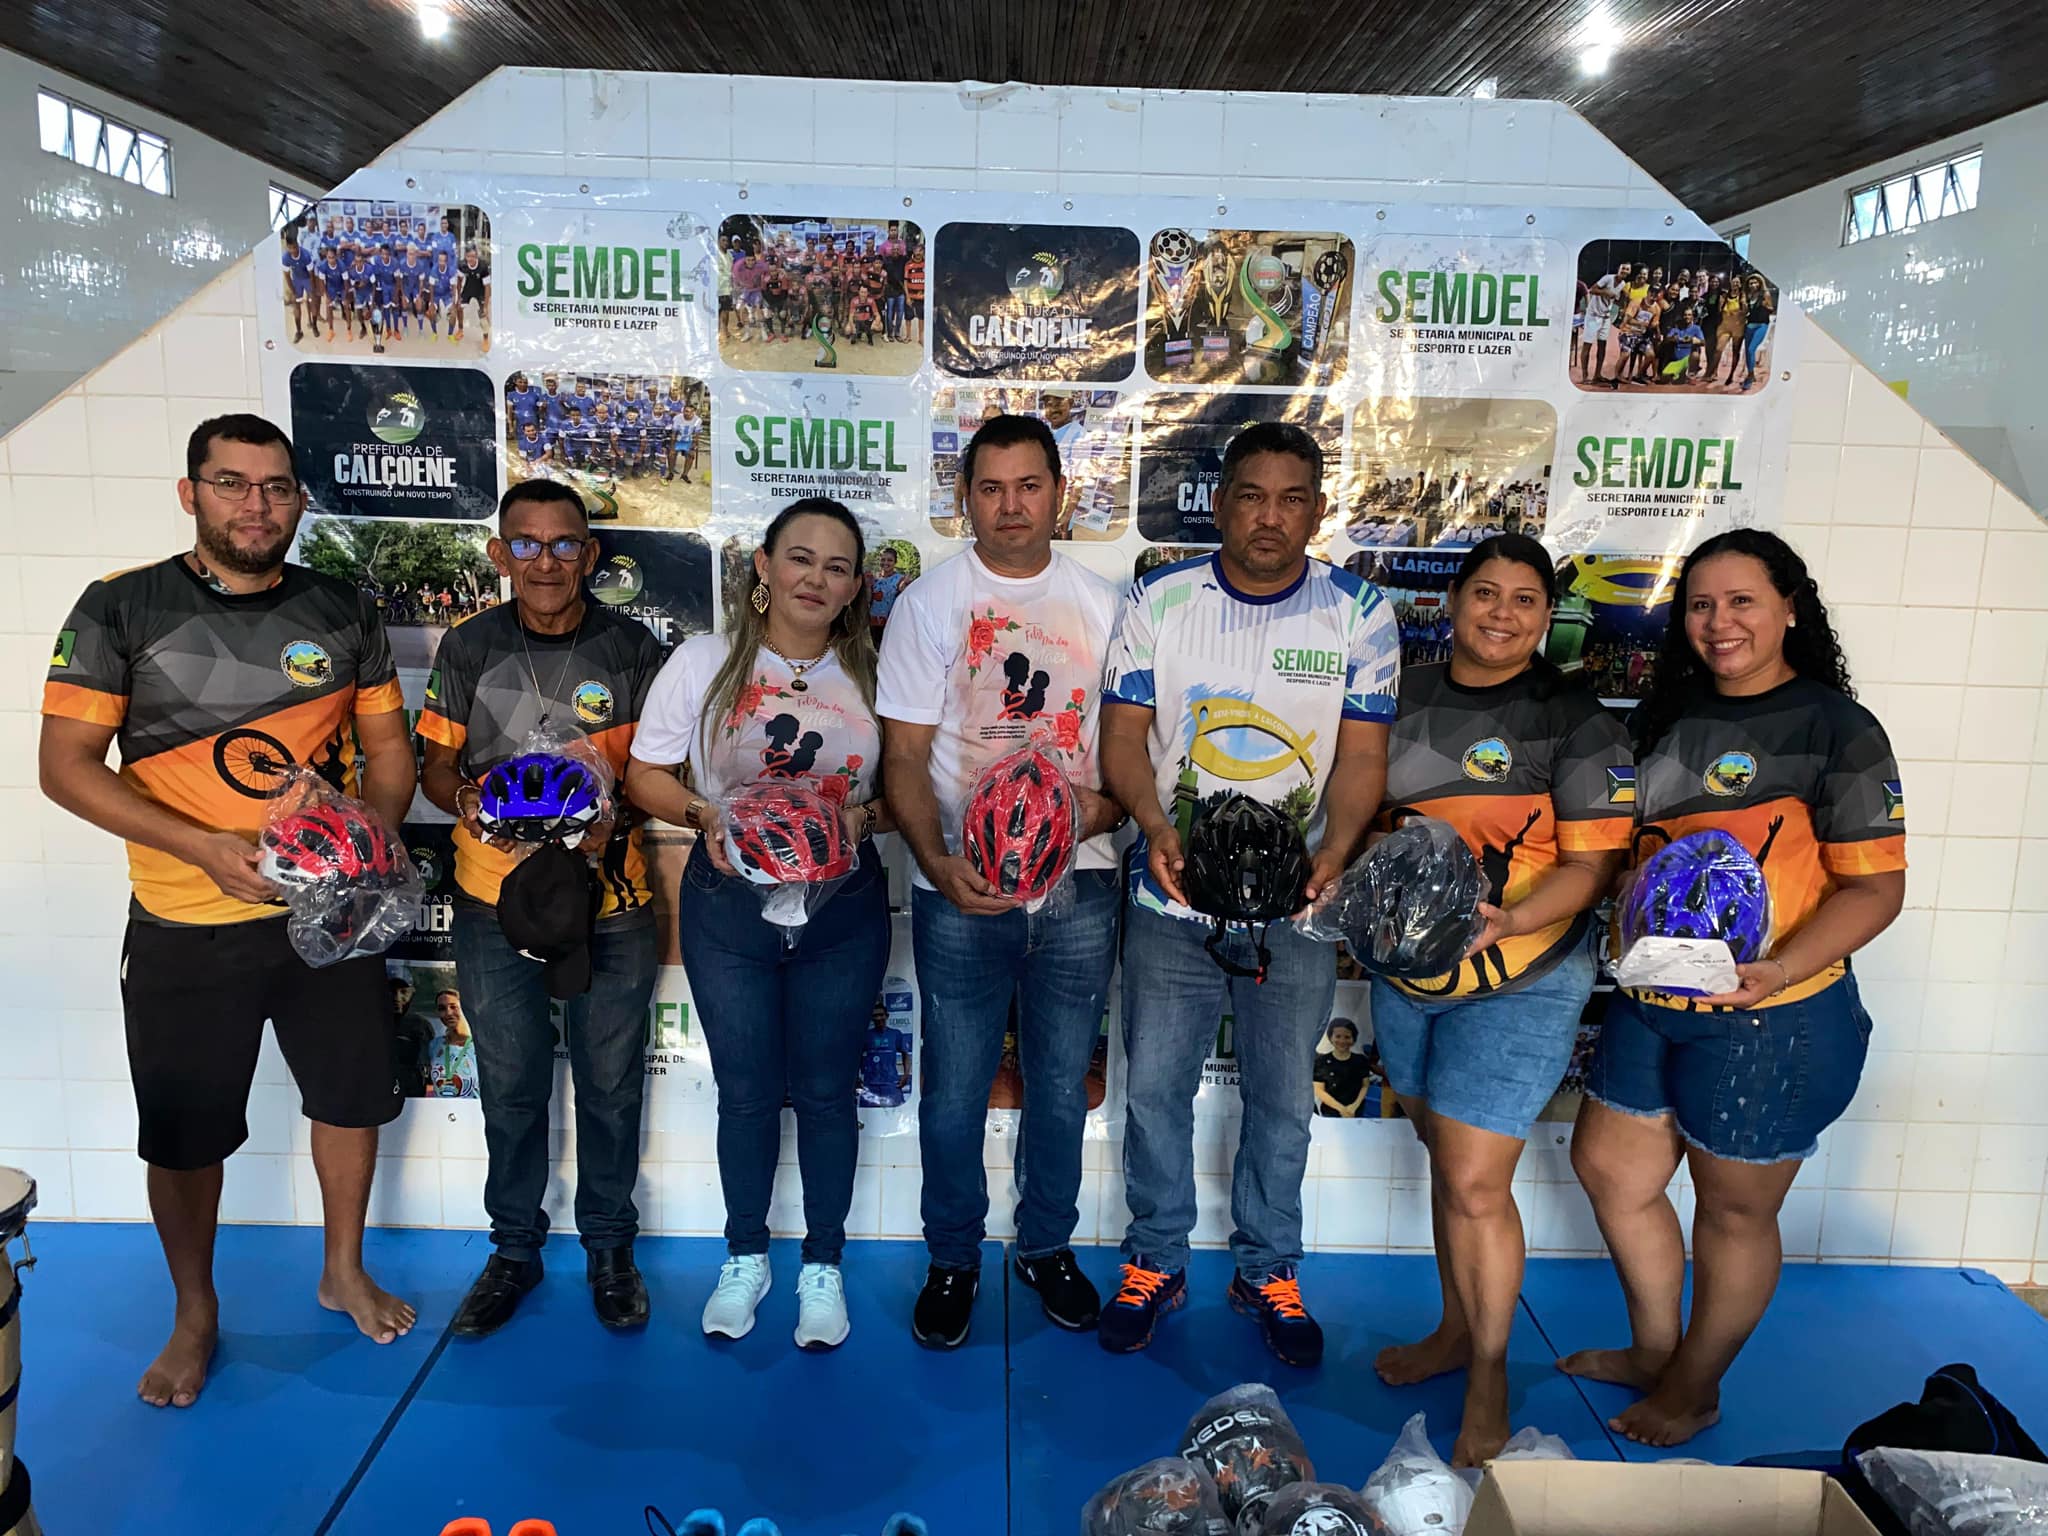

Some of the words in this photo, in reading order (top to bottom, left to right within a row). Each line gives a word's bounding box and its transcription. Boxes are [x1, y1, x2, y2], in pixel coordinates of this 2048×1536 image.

[517, 244, 694, 302] SEMDEL
[1375, 270, 1550, 326] SEMDEL
[533, 302, 599, 315] SECRETARIA
[603, 305, 661, 317] MUNICIPAL
[664, 307, 679, 317] DE
[554, 318, 611, 329] DESPORTO
[614, 319, 621, 329] E
[624, 320, 658, 330] LAZER
[1303, 293, 1321, 348] CAMPEÃO
[969, 315, 1092, 352] CALÇOENE
[1458, 330, 1516, 341] MUNICIPAL
[1519, 332, 1533, 342] DE
[1410, 343, 1465, 354] DESPORTO
[1468, 344, 1475, 354] E
[1478, 345, 1511, 355] LAZER
[353, 443, 423, 456] PREFEITURA
[426, 446, 442, 457] DE
[735, 415, 907, 472] SEMDEL
[1573, 436, 1742, 490] SEMDEL
[334, 453, 458, 489] CALÇOENE
[751, 472, 815, 485] SECRETARIA
[818, 475, 875, 487] MUNICIPAL
[878, 477, 892, 487] DE
[343, 488, 392, 497] CONSTRUINDO
[394, 490, 404, 498] UM
[406, 490, 426, 498] NOVO
[428, 491, 452, 499] TEMPO
[771, 487, 826, 499] DESPORTO
[829, 490, 836, 499] E
[838, 490, 872, 500] LAZER
[1587, 493, 1650, 503] SECRETARIA
[1712, 495, 1726, 505] DE
[1607, 507, 1659, 517] DESPORTO
[1662, 508, 1668, 517] E
[643, 606, 660, 617] DE
[1272, 648, 1346, 675] SEMDEL
